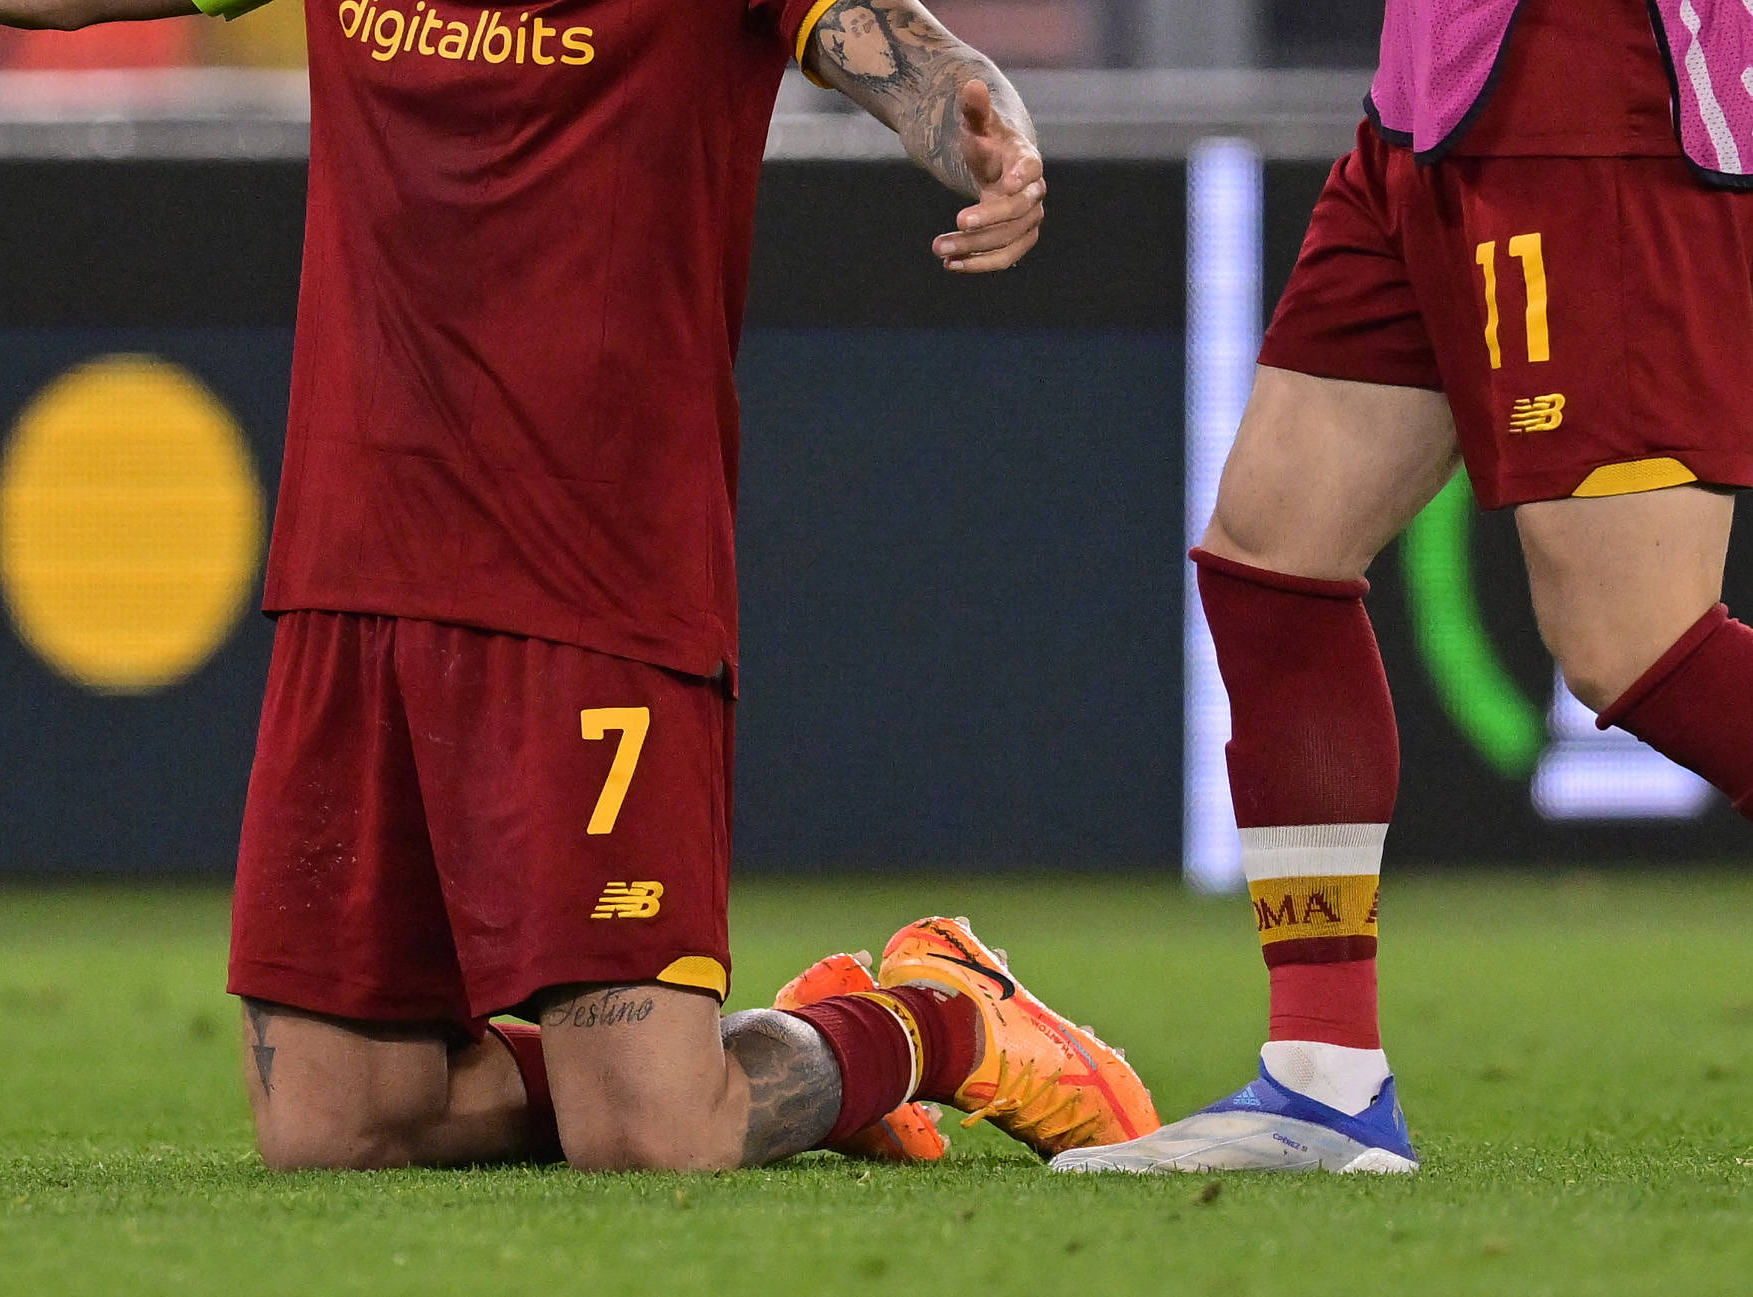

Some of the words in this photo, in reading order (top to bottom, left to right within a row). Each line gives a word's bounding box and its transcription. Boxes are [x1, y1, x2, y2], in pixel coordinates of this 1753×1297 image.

[1475, 232, 1550, 369] 11
[580, 707, 650, 835] 7
[1030, 1017, 1074, 1061] PHANTOM
